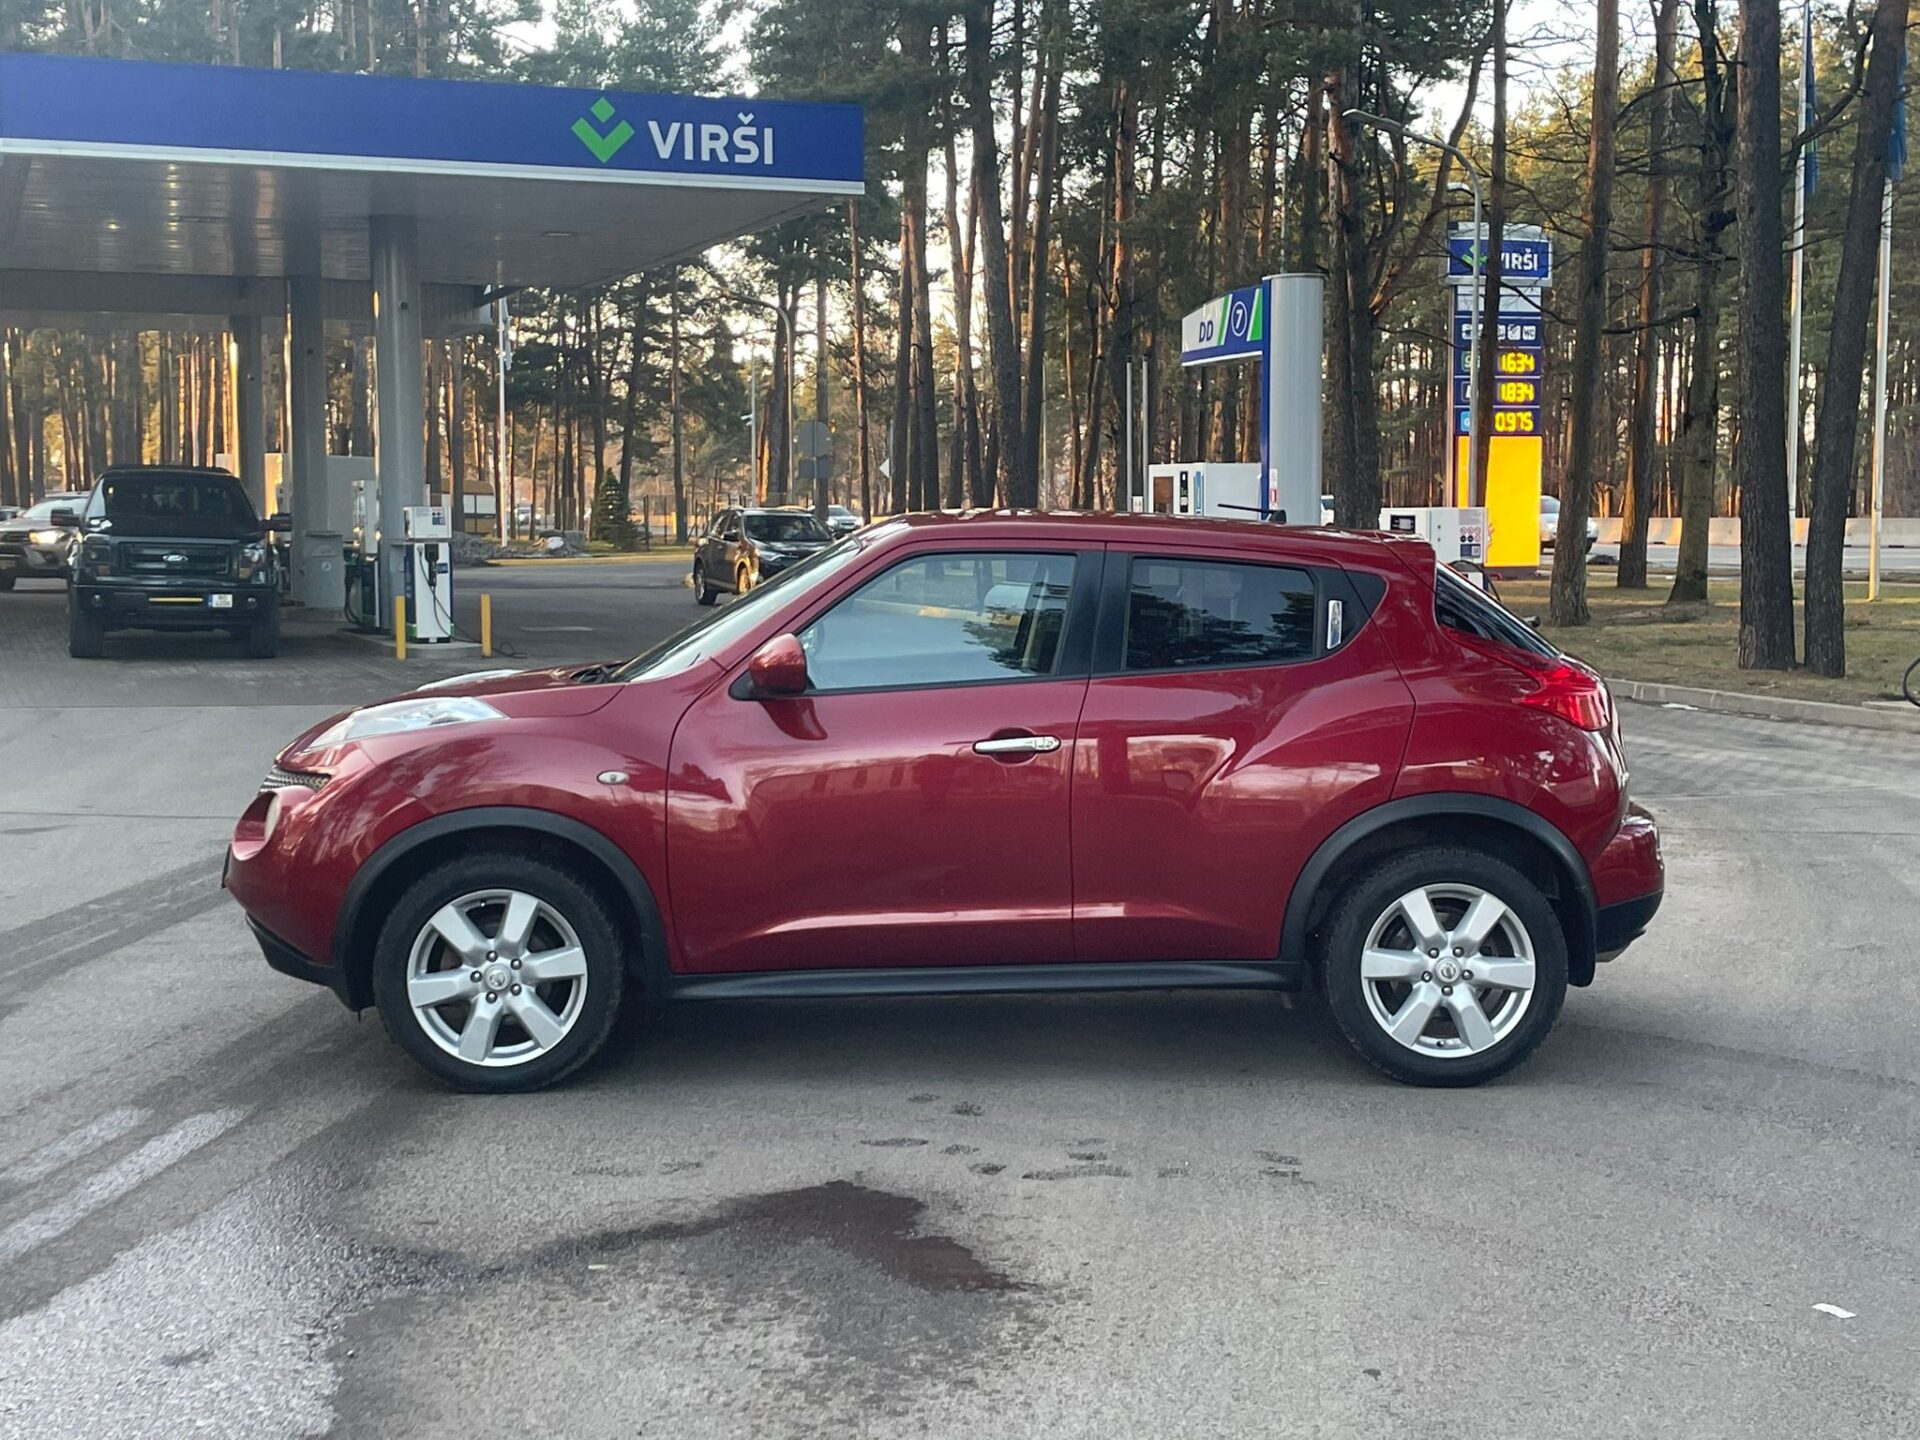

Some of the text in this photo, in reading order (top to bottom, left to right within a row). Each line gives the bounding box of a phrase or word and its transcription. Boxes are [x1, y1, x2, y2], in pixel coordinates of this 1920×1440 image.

[648, 112, 774, 165] VIRŠI
[1235, 309, 1243, 330] 7
[1199, 320, 1214, 343] DD
